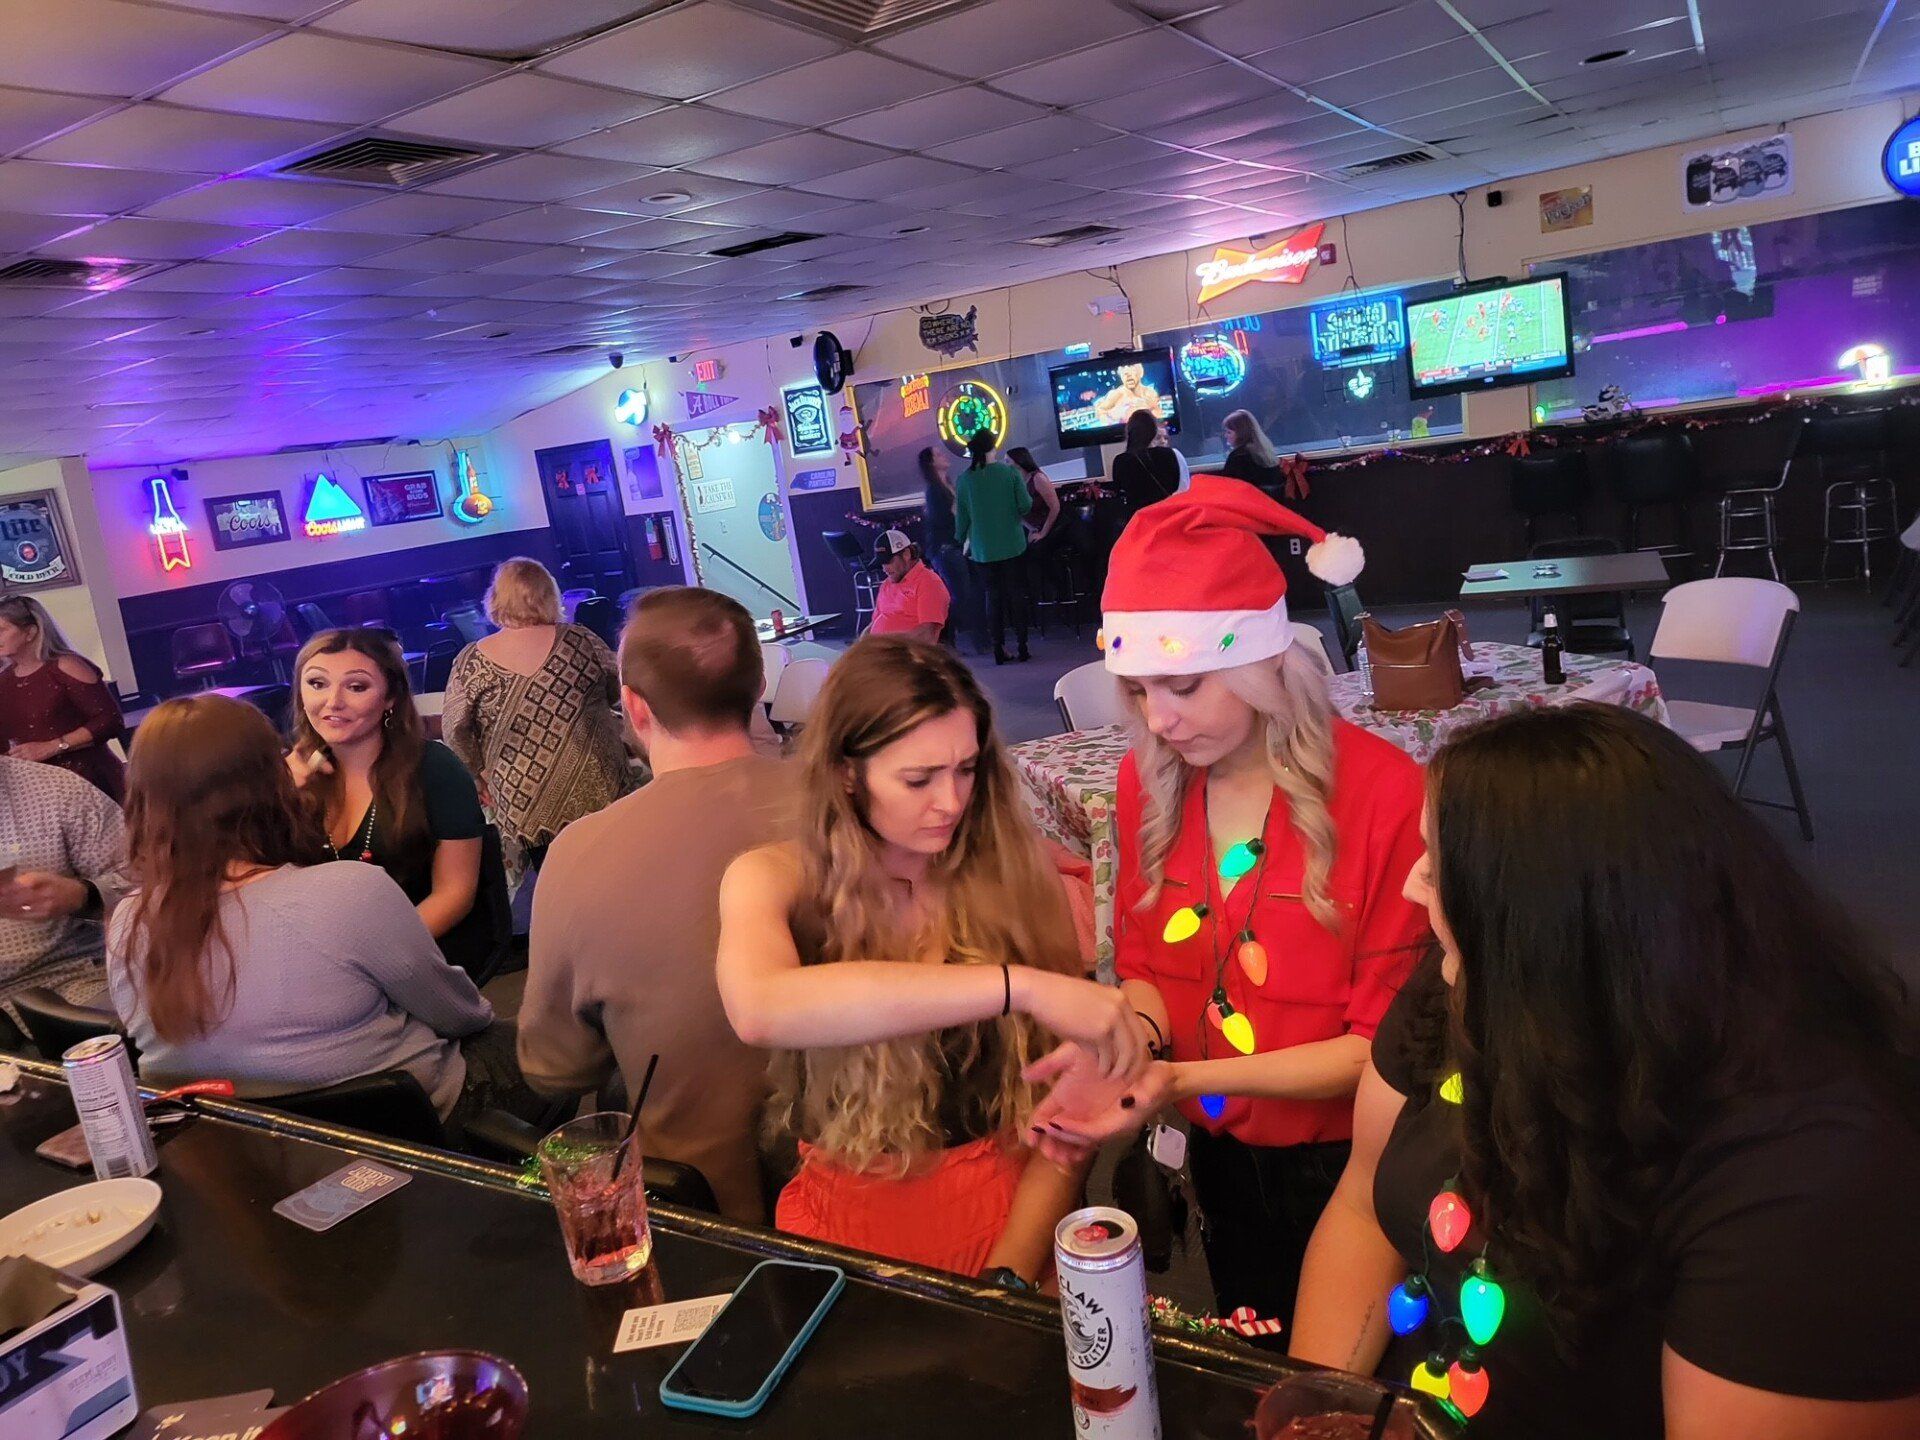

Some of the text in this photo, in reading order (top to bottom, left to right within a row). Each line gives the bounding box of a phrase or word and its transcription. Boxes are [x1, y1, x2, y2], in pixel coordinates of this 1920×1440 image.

[1196, 247, 1318, 286] Budweiser
[697, 361, 715, 381] EXIT
[404, 482, 427, 491] GRAB
[703, 484, 719, 494] TAKE
[808, 479, 835, 488] PANTHERS
[406, 492, 429, 500] BUDS
[229, 515, 270, 532] Coors
[36, 566, 59, 579] BEER
[1059, 1275, 1104, 1315] CLAW
[1078, 1327, 1107, 1365] SELTZER
